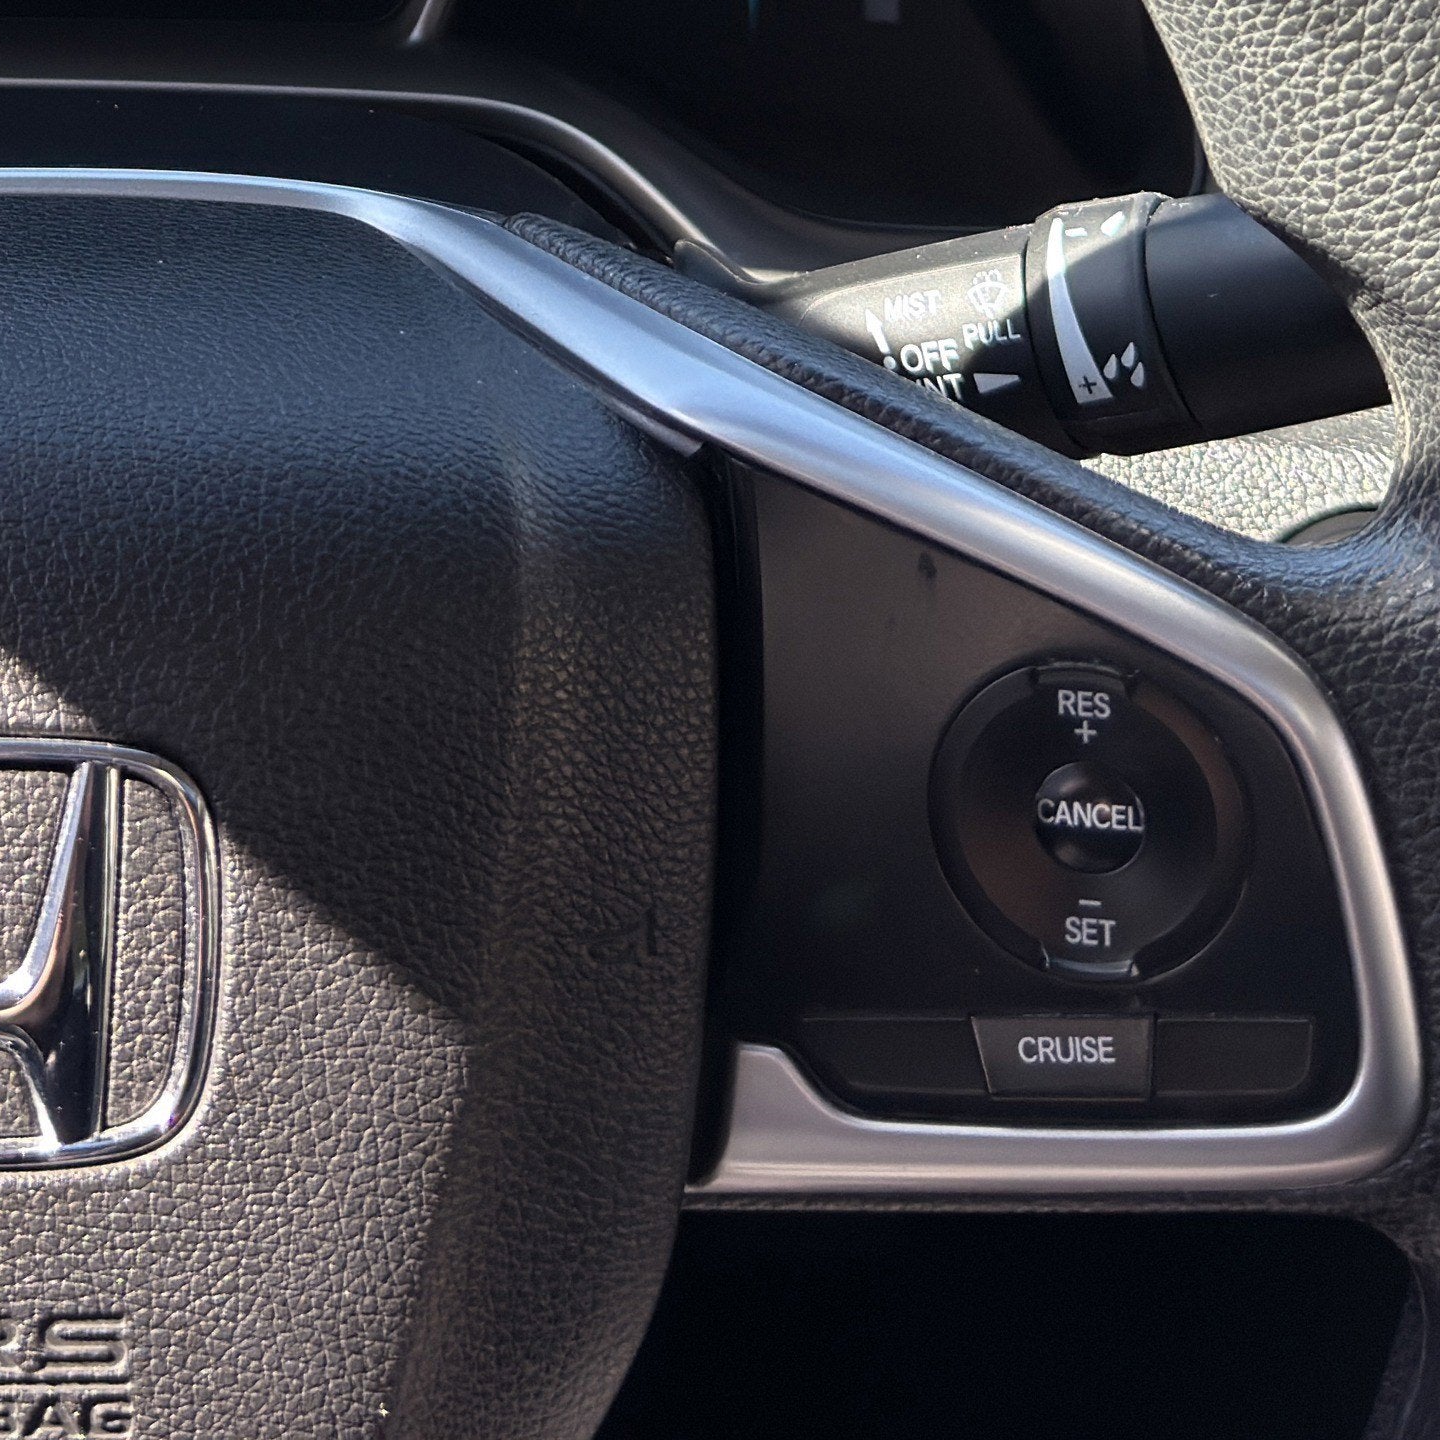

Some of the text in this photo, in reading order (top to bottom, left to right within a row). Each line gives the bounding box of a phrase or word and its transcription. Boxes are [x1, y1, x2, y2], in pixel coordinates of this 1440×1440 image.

[883, 289, 942, 323] MIST
[962, 318, 1021, 350] PULL
[899, 337, 960, 374] OFF
[1057, 689, 1111, 719] RES
[1036, 797, 1144, 833] CANCEL
[1065, 916, 1117, 948] SET
[1017, 1036, 1117, 1065] CRUISE
